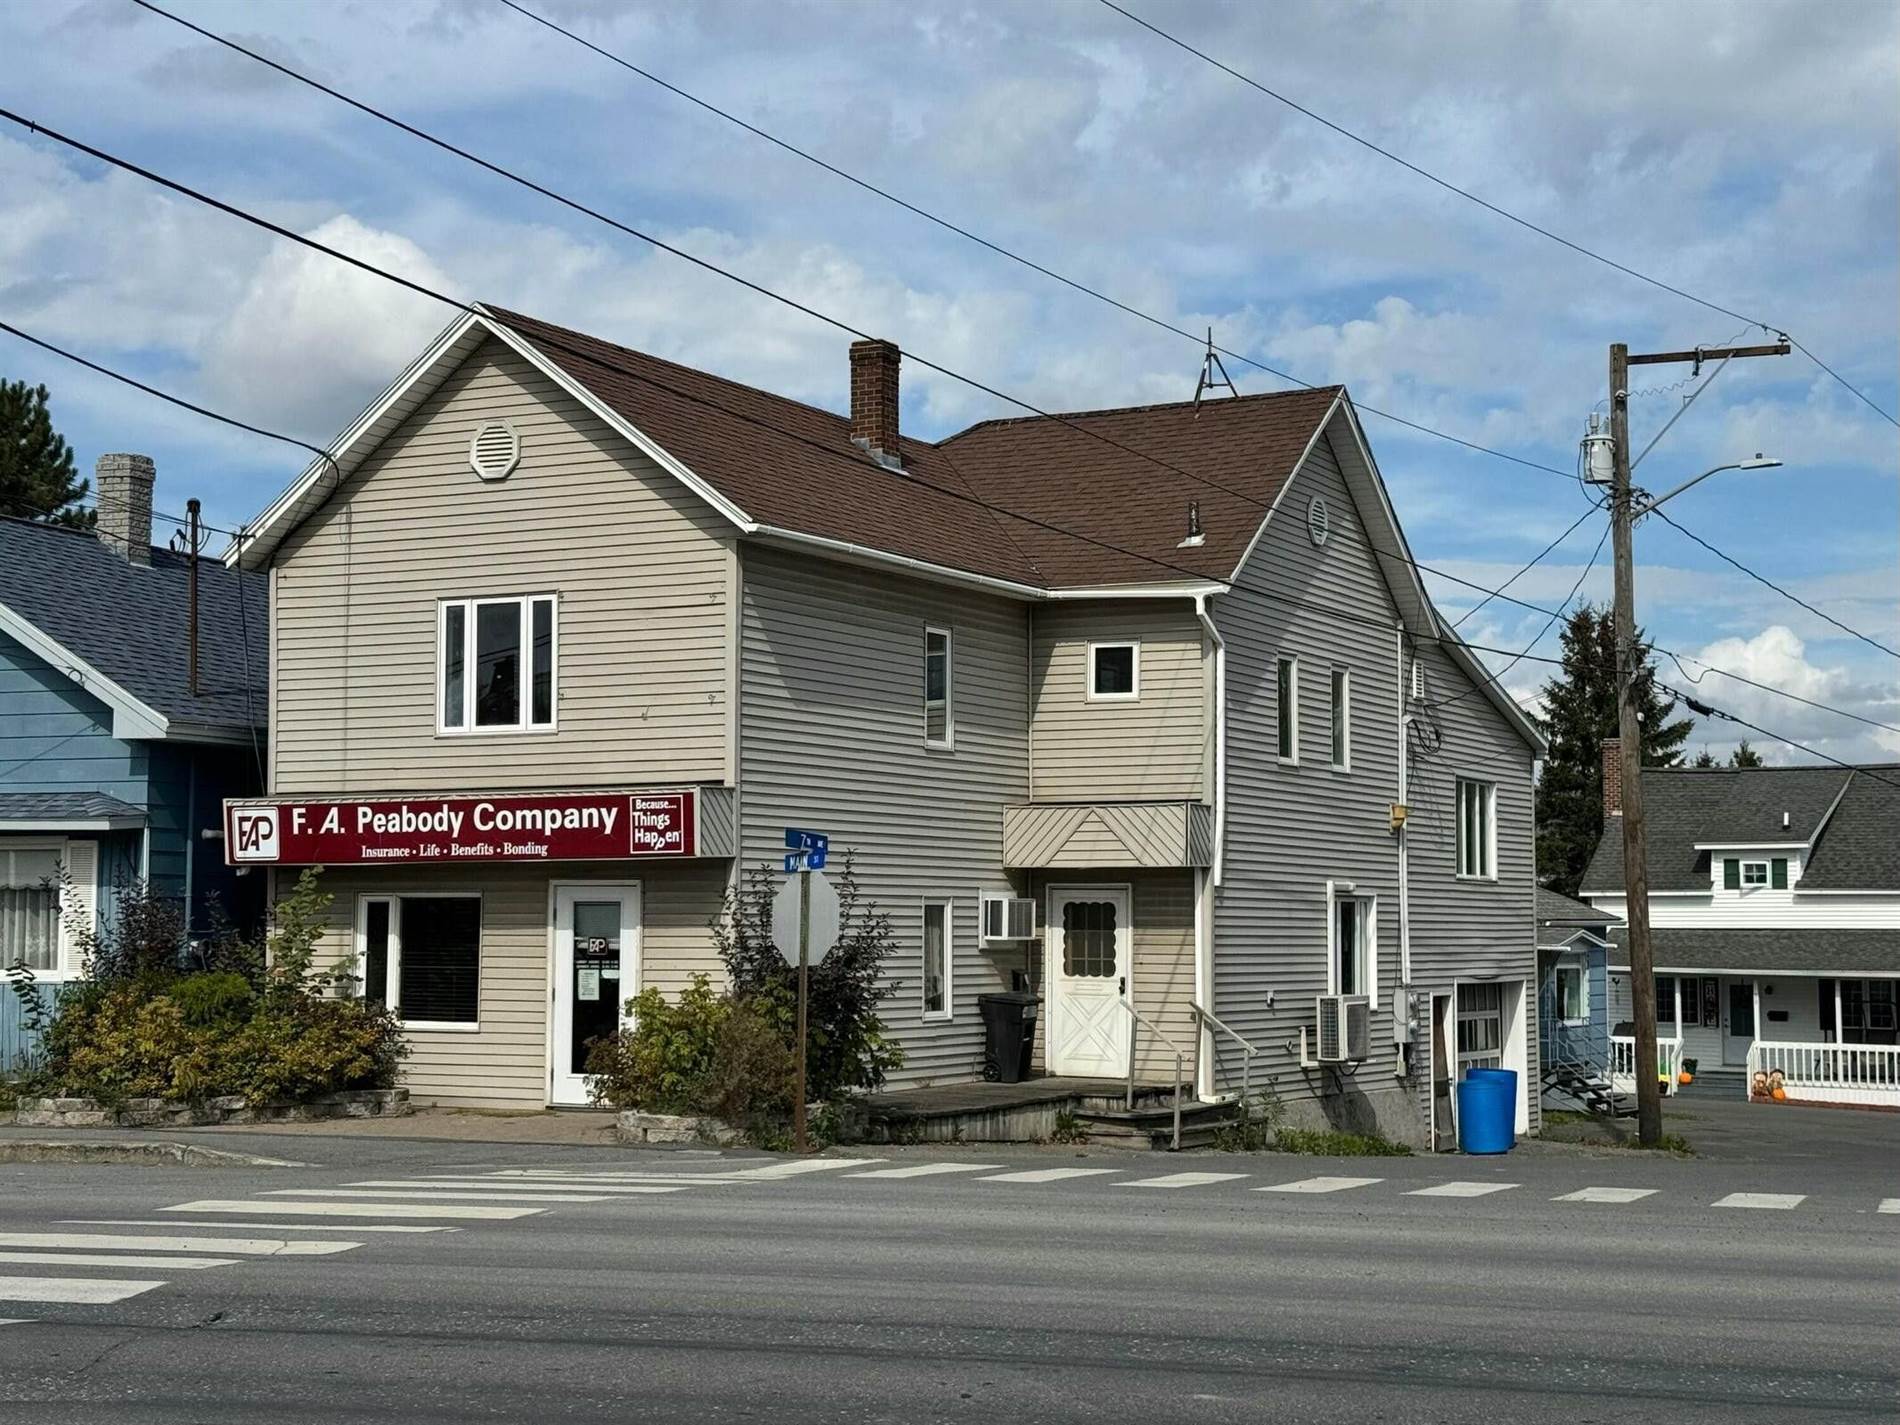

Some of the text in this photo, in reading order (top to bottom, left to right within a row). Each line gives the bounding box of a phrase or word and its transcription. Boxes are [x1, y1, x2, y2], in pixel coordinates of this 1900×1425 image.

[292, 803, 618, 838] F. A. Peabody Company
[632, 811, 670, 830] Things
[361, 841, 549, 858] Insurance Life Benefits Bonding
